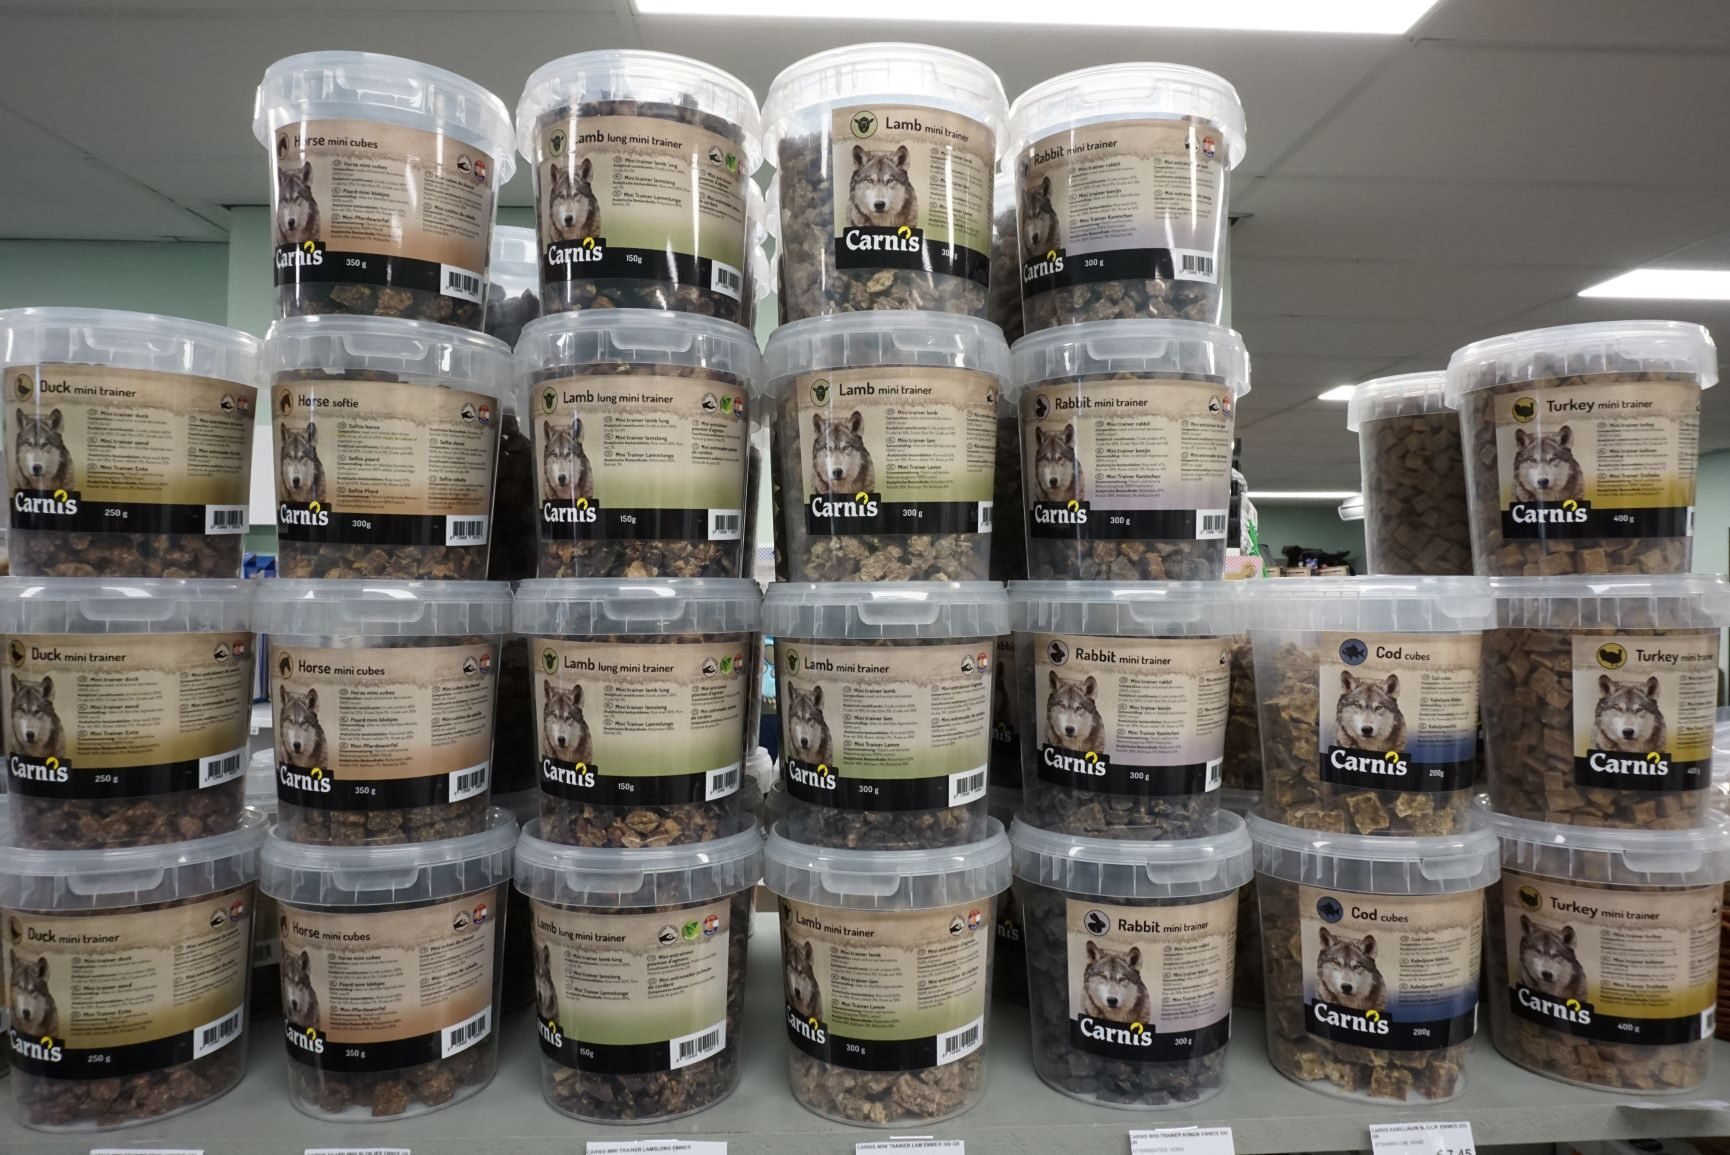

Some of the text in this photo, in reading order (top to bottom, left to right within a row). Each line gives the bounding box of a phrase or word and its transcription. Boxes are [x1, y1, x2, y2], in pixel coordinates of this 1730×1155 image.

[886, 117, 968, 143] Lamb mini trainer
[294, 135, 378, 149] Horse mini cubes
[571, 130, 682, 149] amb lung mini trainer
[1034, 140, 1118, 166] Rabbit mini trainer
[846, 226, 919, 252] Carnis
[276, 241, 323, 268] Carnis
[548, 237, 603, 265] Carnis
[626, 254, 642, 264] 150g
[346, 258, 360, 266] 350
[1023, 250, 1064, 282] Carnis
[40, 380, 136, 397] Duck mini trainer
[563, 390, 673, 404] Lamb lung mini trainer
[839, 382, 932, 396] Lamb mini trainer
[298, 395, 359, 408] Horse softie
[1055, 397, 1148, 410] Rabbit mini trainer
[1547, 399, 1653, 413] Turkey mini trainer
[15, 489, 78, 515] Carnis
[544, 498, 596, 522] Carnis
[812, 492, 878, 517] Carnis
[105, 509, 120, 517] 250
[280, 501, 328, 526] Carnis
[620, 515, 636, 524] 150g
[918, 510, 922, 518] g
[1035, 500, 1087, 524] Carnis
[1110, 516, 1124, 524] 300
[1512, 500, 1587, 523] Carnis
[1630, 516, 1634, 524] g
[352, 520, 371, 529] 300g
[32, 647, 126, 662] Duck mini trainer
[1076, 648, 1172, 665] Rabbit mini trainer
[1376, 646, 1430, 661] Cod cubes
[1636, 650, 1679, 665] Turkey
[299, 660, 385, 675] Horse mini cubes
[564, 656, 674, 674] Lamb lung mini trainer
[805, 657, 890, 673] Lamb mini trainer
[11, 757, 69, 782] Carnis
[1044, 748, 1106, 776] Carnis
[1331, 750, 1408, 775] Carnis
[1590, 752, 1668, 775] Carnis
[113, 776, 118, 784] g
[280, 768, 331, 793] Carnis
[543, 759, 595, 788] Carnis
[789, 761, 836, 790] Carnis
[371, 788, 376, 796] g
[618, 782, 634, 792] 150g
[859, 785, 872, 793] 300
[1352, 906, 1408, 923] Cod cubes
[1550, 897, 1660, 920] Turkey mini trainer
[293, 921, 370, 941] Horse mini cubes
[537, 919, 626, 942] Lamb lung mini trainer
[796, 912, 875, 938] Lamb mini trainer
[1118, 919, 1208, 933] Rabbit mini trainer
[28, 927, 120, 944] Duck mini trainer
[1518, 988, 1591, 1025] Carnis
[787, 1005, 826, 1044] Carnis
[1314, 1003, 1389, 1035] Carnis
[1617, 1023, 1633, 1031] 400
[285, 1018, 324, 1054] Carnis
[1080, 1017, 1152, 1046] Carnis
[10, 1030, 62, 1062] Carnis
[846, 1044, 859, 1052] 300
[88, 1055, 111, 1063] 250 g
